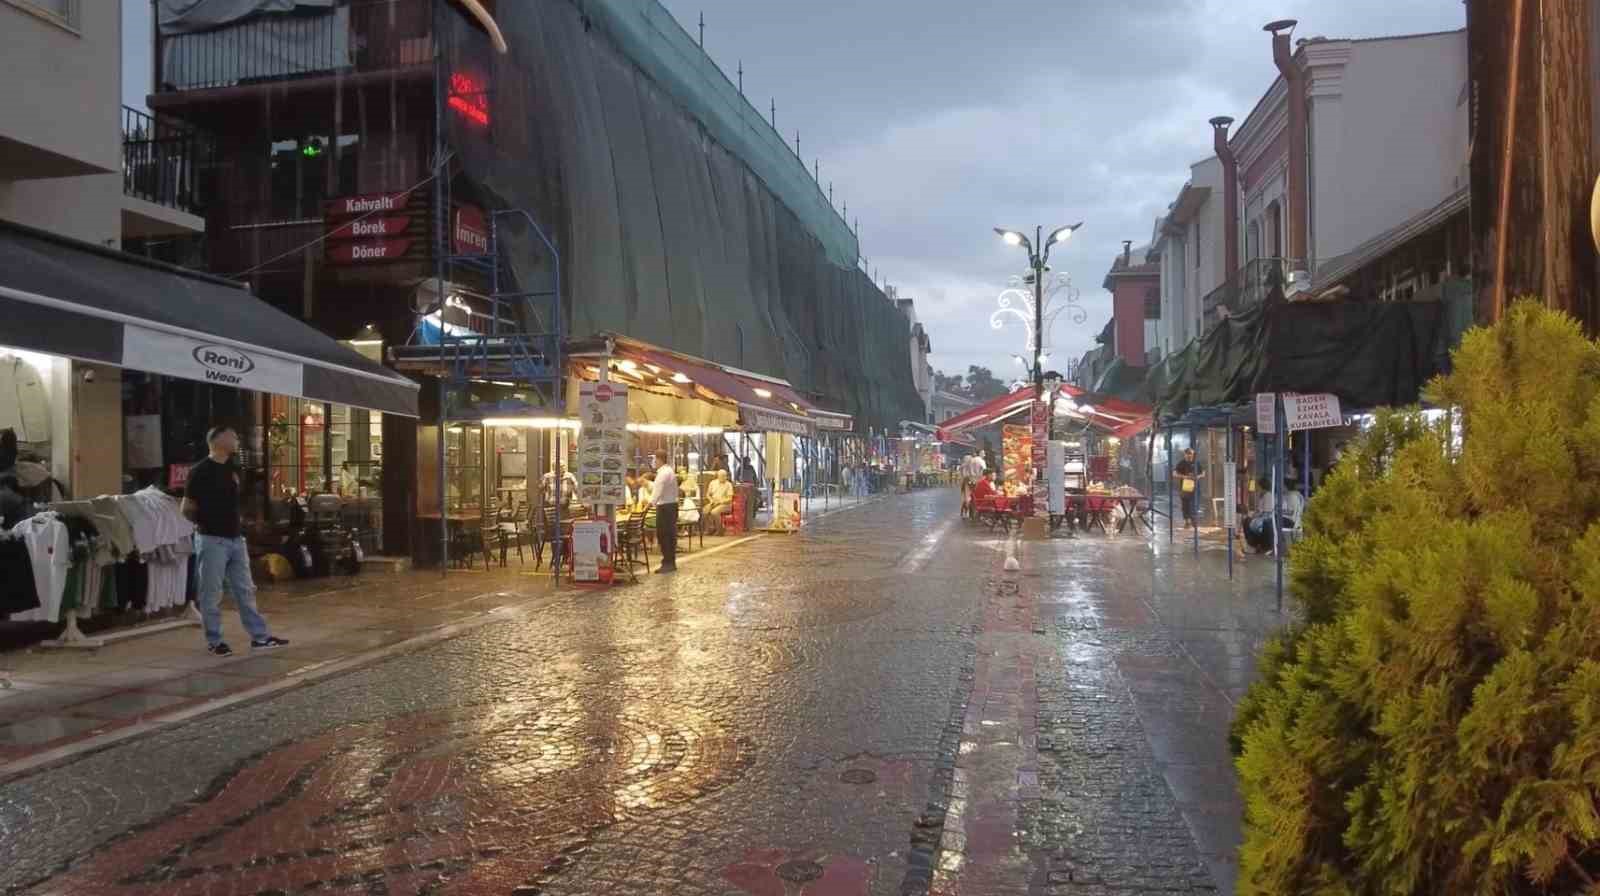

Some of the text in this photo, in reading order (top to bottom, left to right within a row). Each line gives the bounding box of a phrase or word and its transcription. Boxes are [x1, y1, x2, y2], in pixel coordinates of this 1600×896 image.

[346, 197, 394, 212] Kahvaltı
[352, 219, 386, 235] Börek
[352, 246, 386, 259] Döner
[204, 350, 244, 369] Roni
[206, 369, 242, 384] Wear
